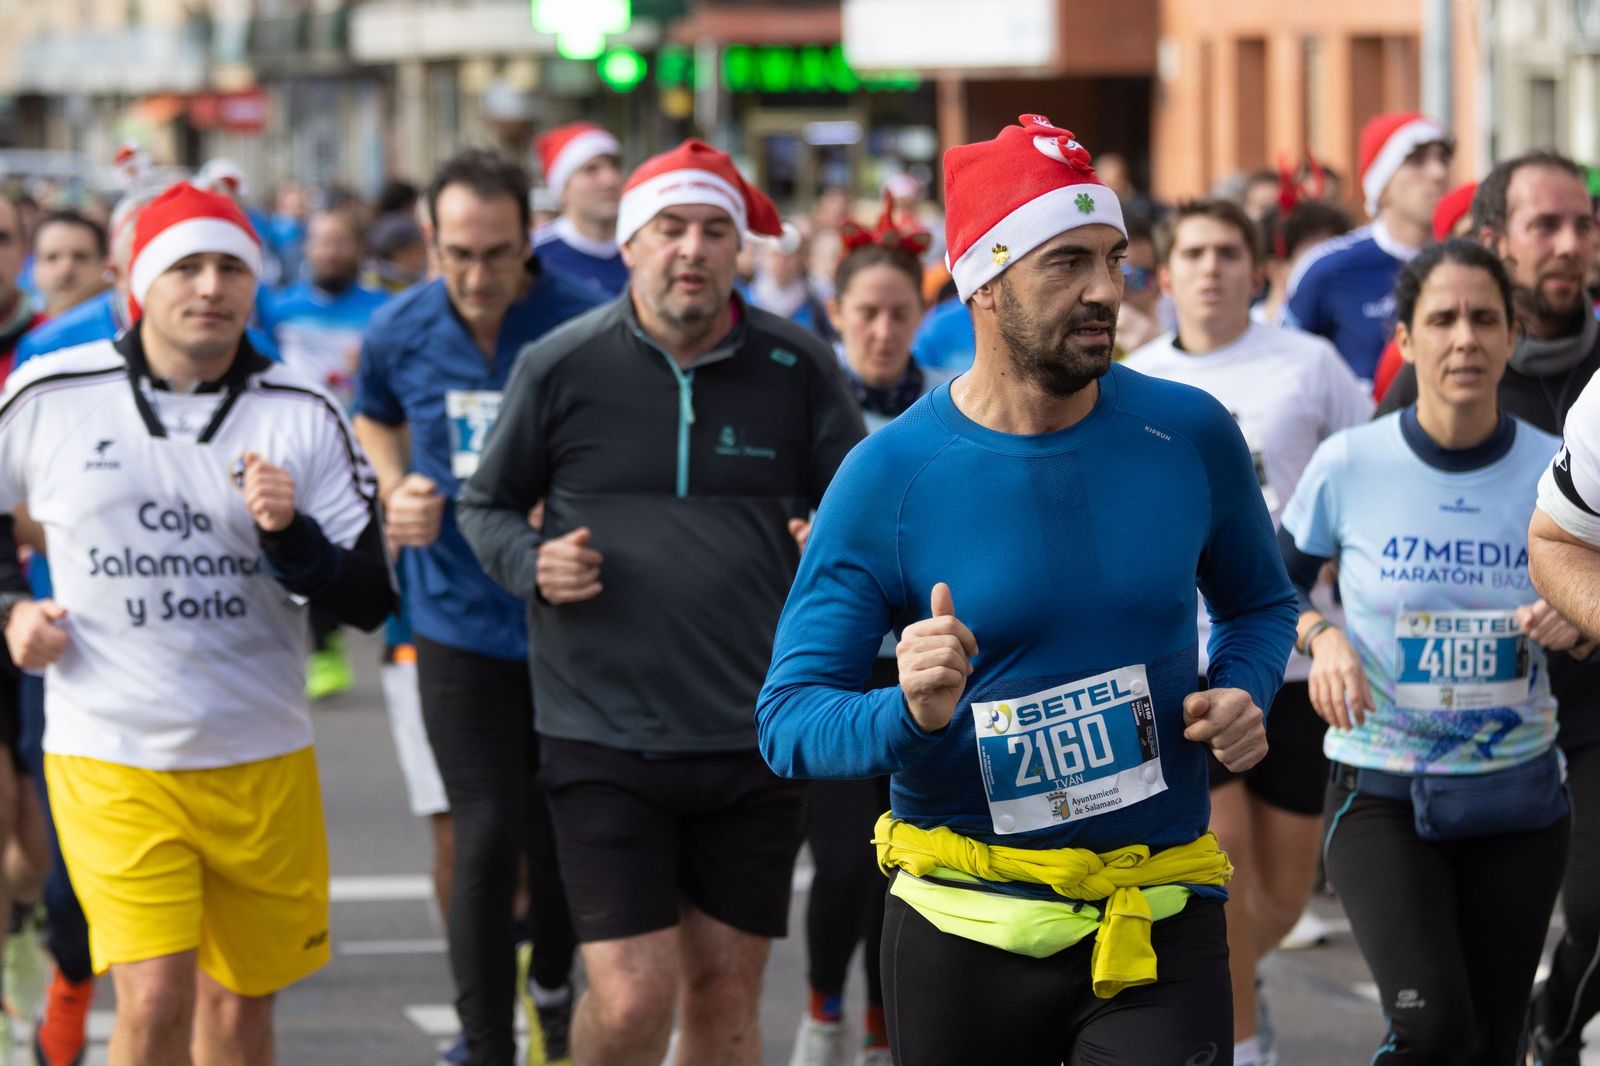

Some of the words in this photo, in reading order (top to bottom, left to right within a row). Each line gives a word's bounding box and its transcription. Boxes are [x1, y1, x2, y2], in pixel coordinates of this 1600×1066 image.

[138, 501, 213, 540] Caja
[88, 547, 260, 577] Salamanc
[1380, 567, 1484, 585] MARATÓN
[126, 598, 146, 626] y
[161, 590, 247, 621] Soria
[1434, 617, 1519, 633] SETEL
[1418, 638, 1498, 678] 4166
[1016, 679, 1131, 727] SETEL
[1007, 713, 1115, 787] 2160
[1053, 774, 1084, 790] IVÁN
[1071, 787, 1120, 806] Ayuntamiento
[1074, 807, 1084, 816] de
[1084, 797, 1123, 813] Salamanca
